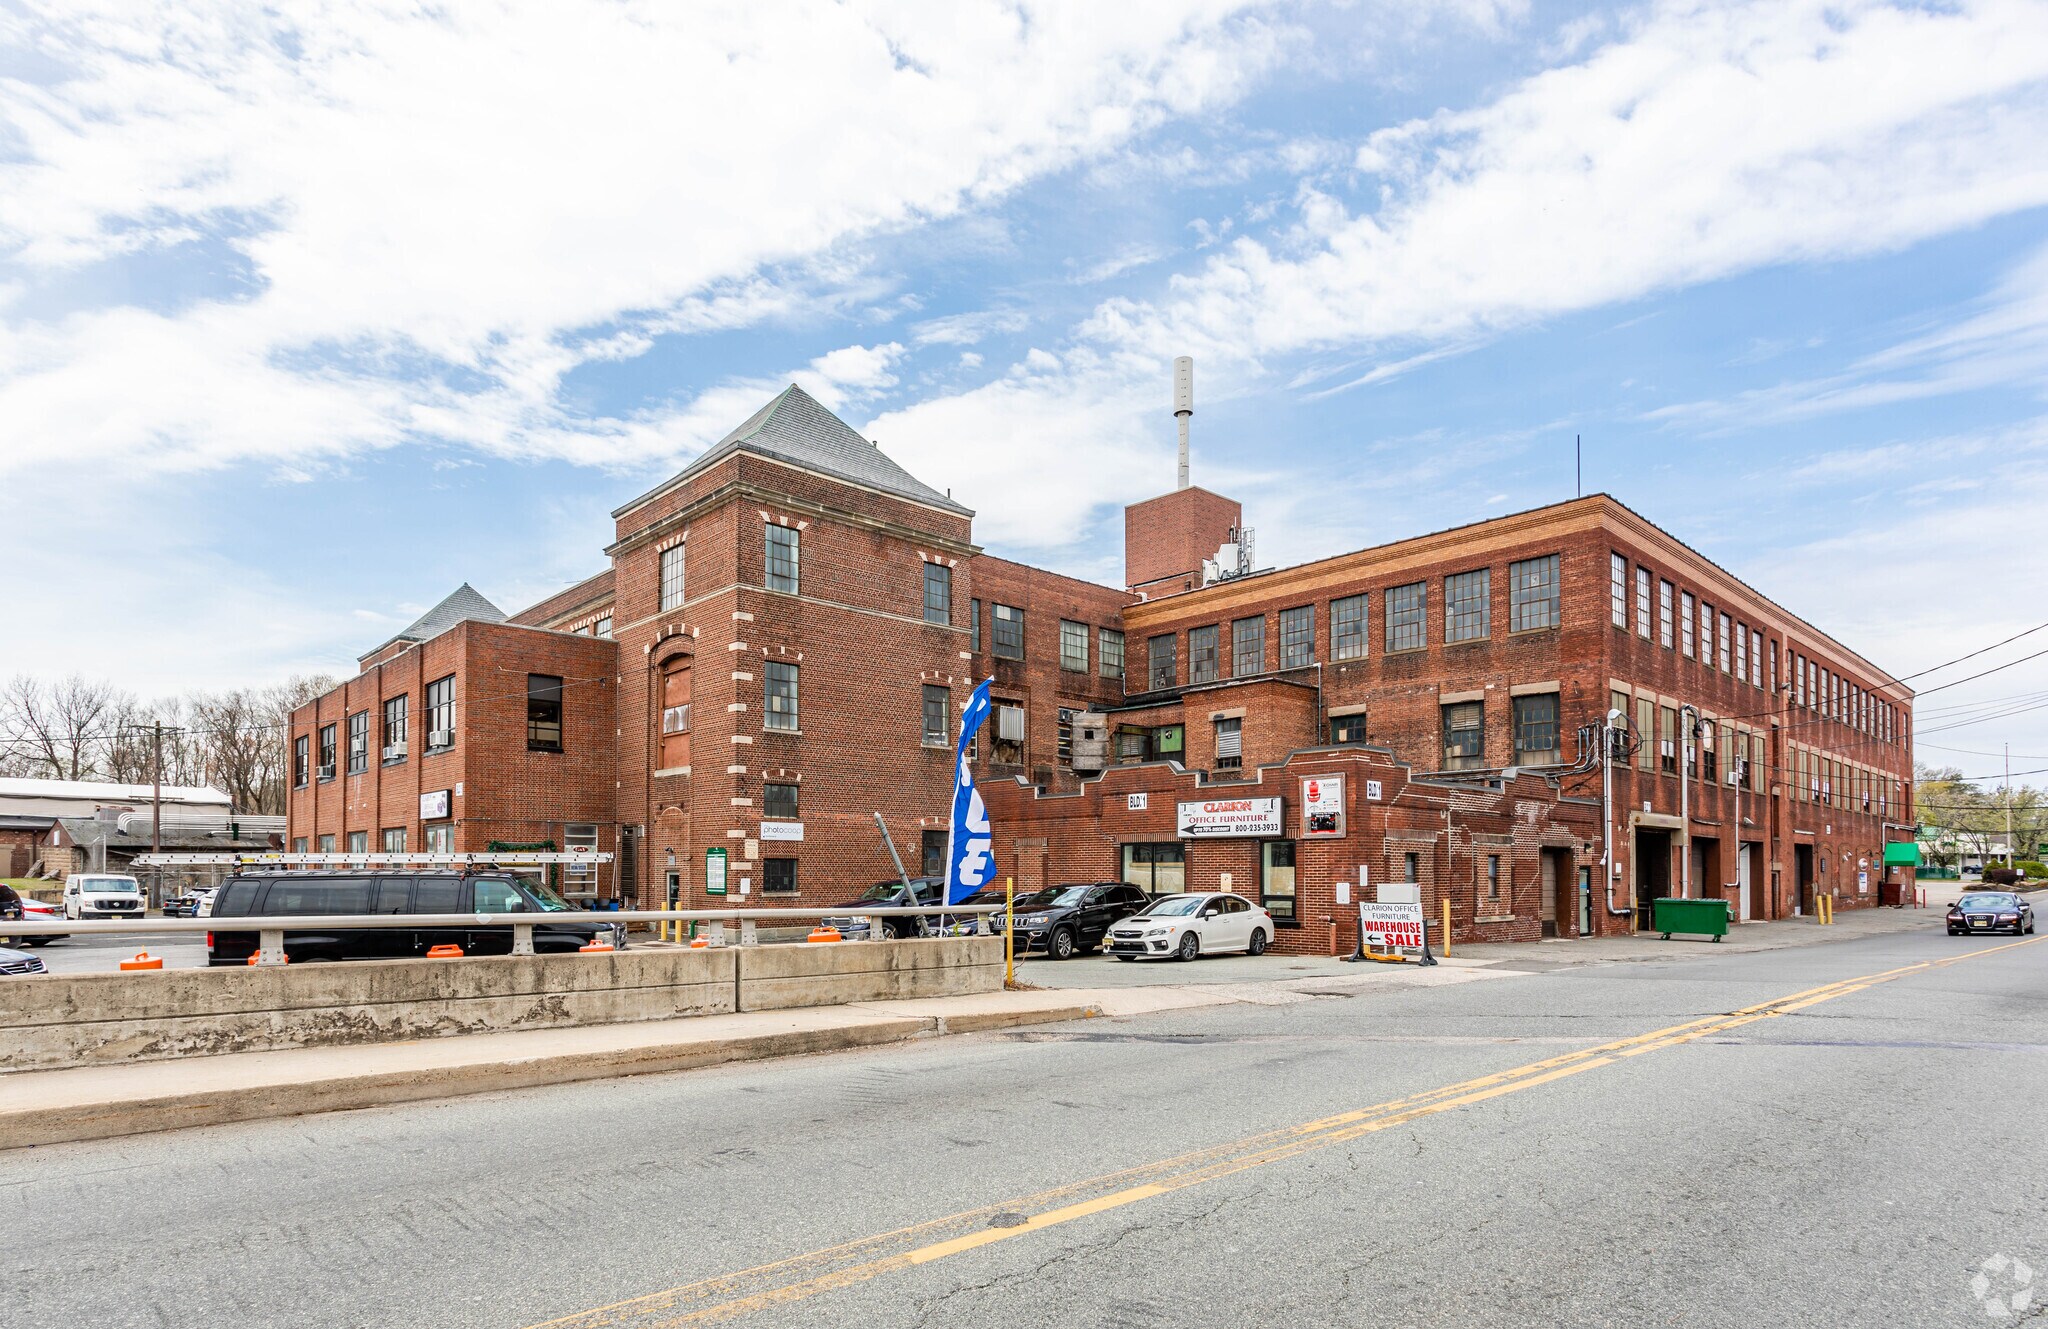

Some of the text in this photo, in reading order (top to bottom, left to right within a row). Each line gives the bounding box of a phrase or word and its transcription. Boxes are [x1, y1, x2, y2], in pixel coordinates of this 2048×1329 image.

[1203, 801, 1252, 813] CLARION
[1189, 814, 1269, 824] OFFICE FURNITURE
[763, 826, 802, 834] photocoop
[1235, 824, 1278, 832] 800-235-3933
[1364, 921, 1421, 933] WAREHOUSE
[1384, 933, 1422, 946] SALE
